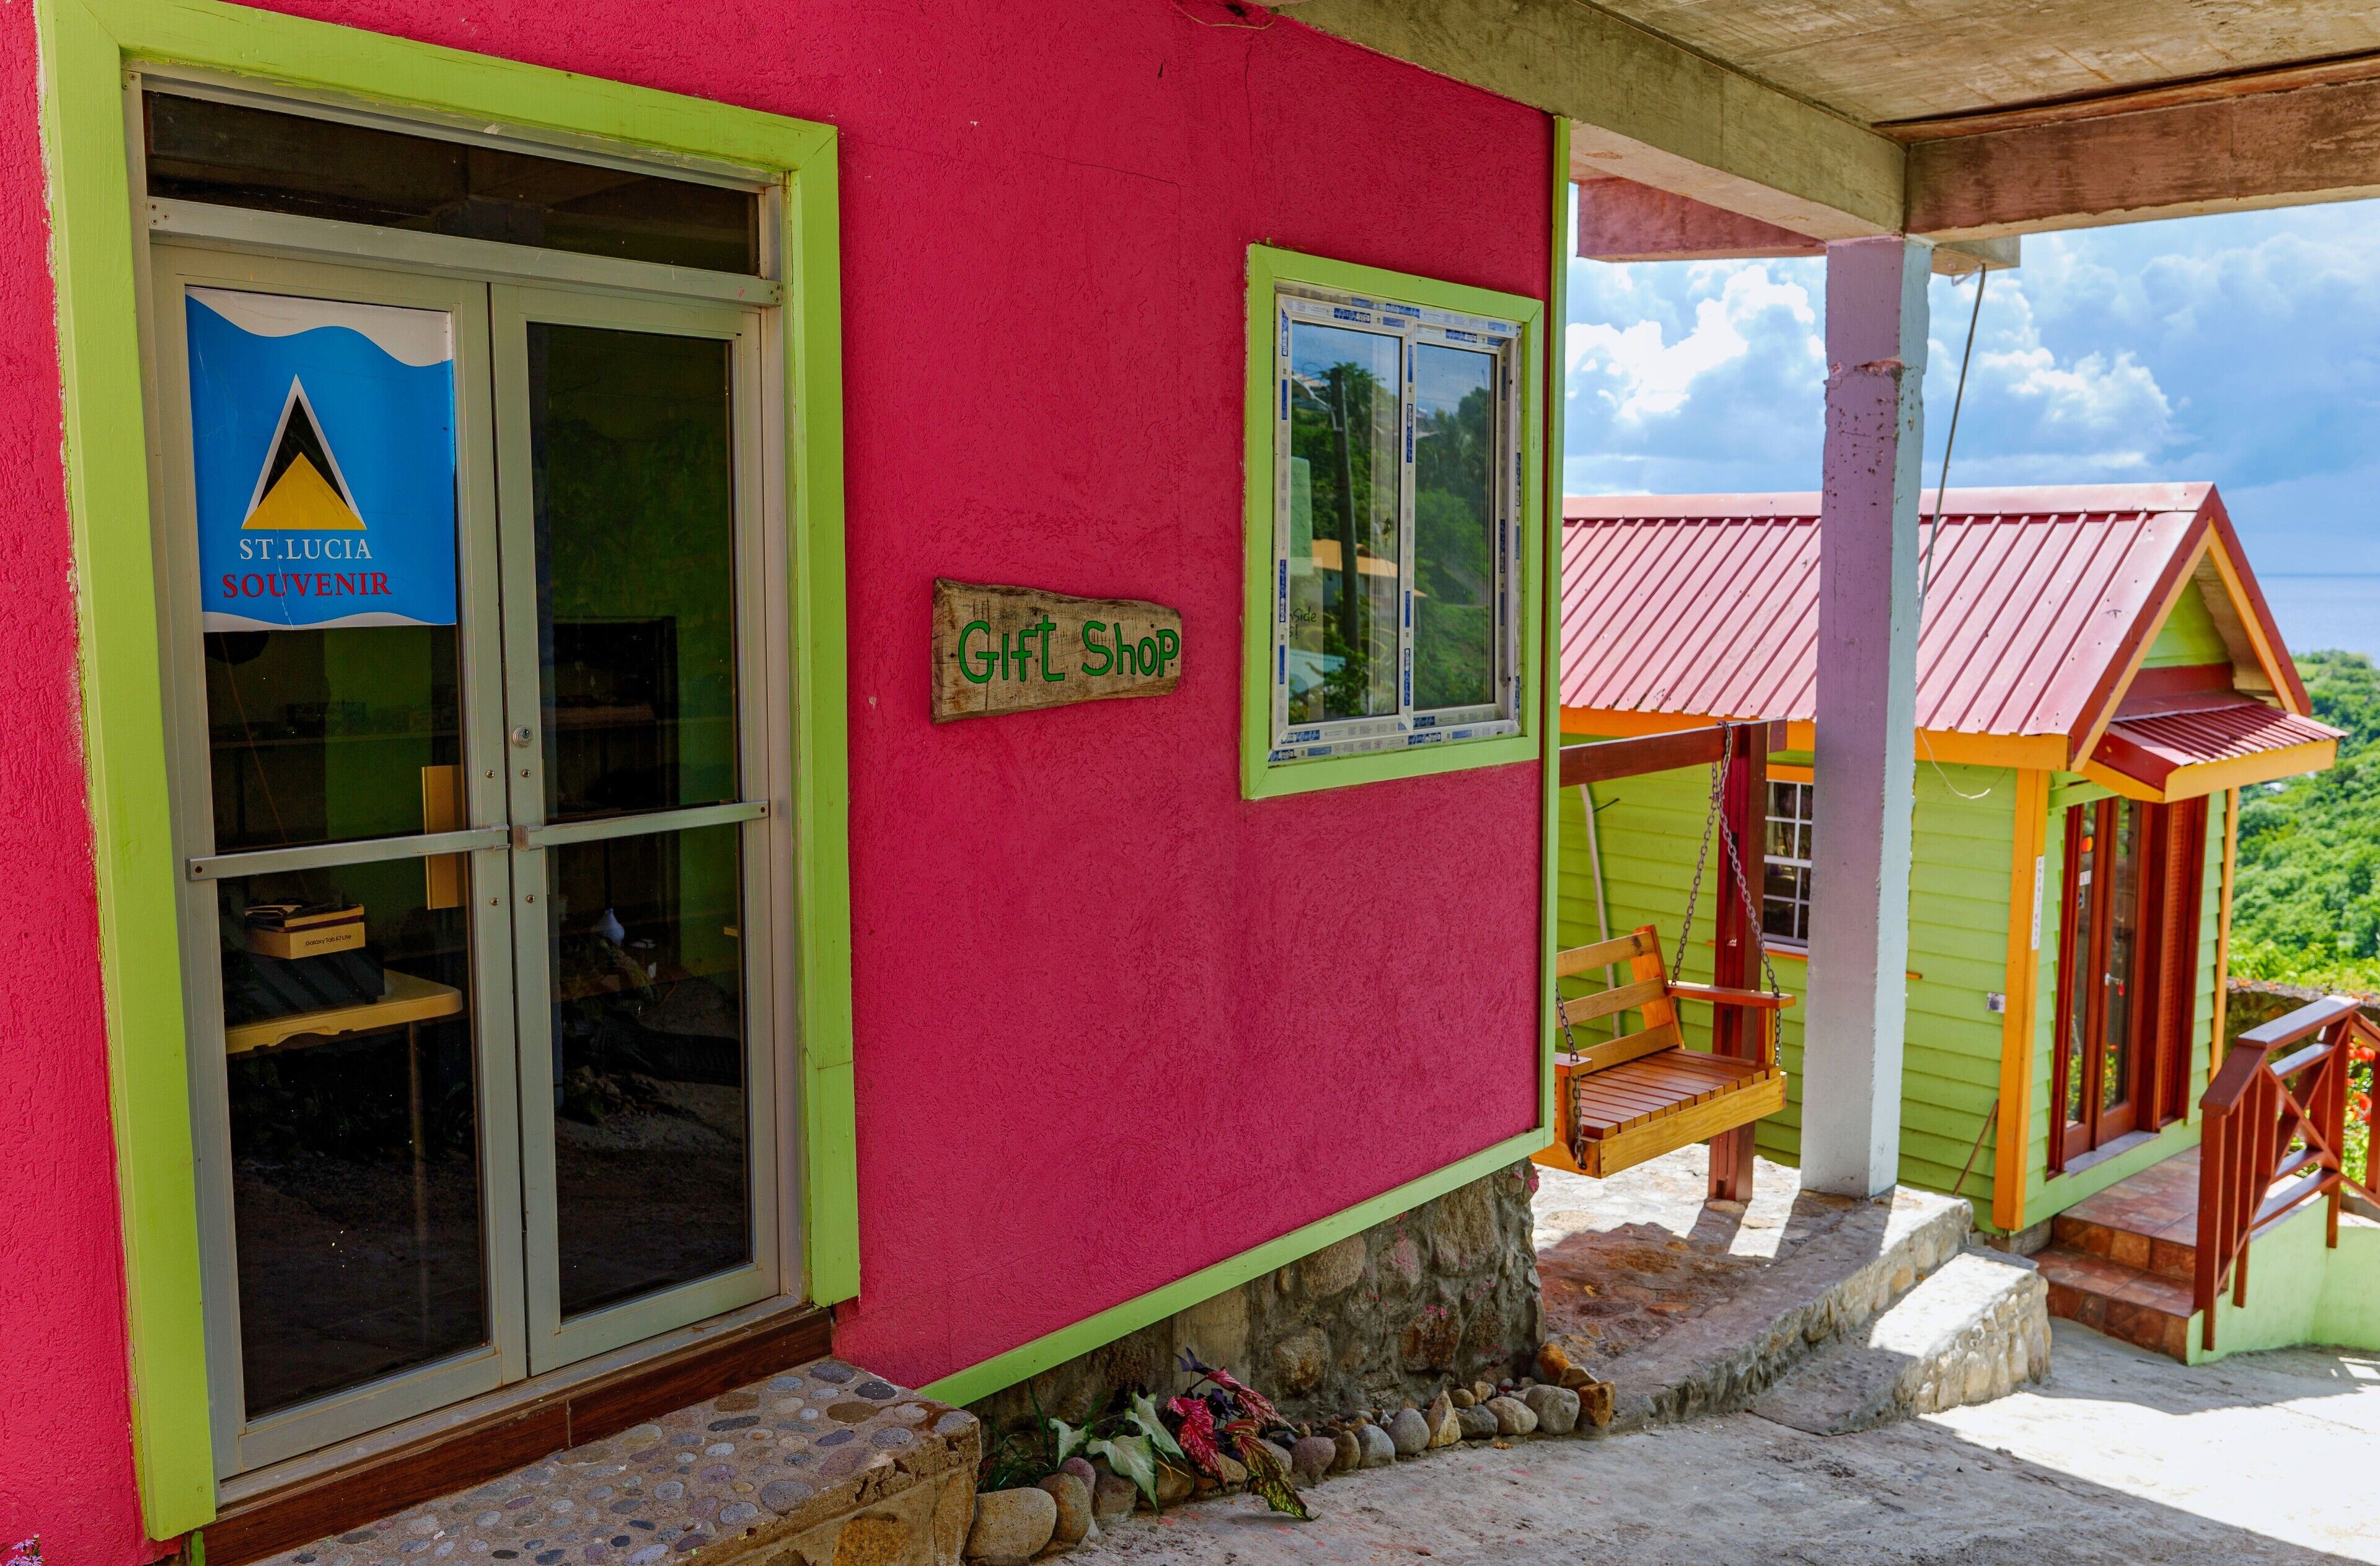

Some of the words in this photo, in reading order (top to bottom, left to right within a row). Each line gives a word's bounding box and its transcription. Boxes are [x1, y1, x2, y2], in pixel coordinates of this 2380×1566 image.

[239, 538, 372, 559] ST.LUCIA
[222, 572, 392, 598] SOUVENIR
[305, 938, 325, 946] Galaxy
